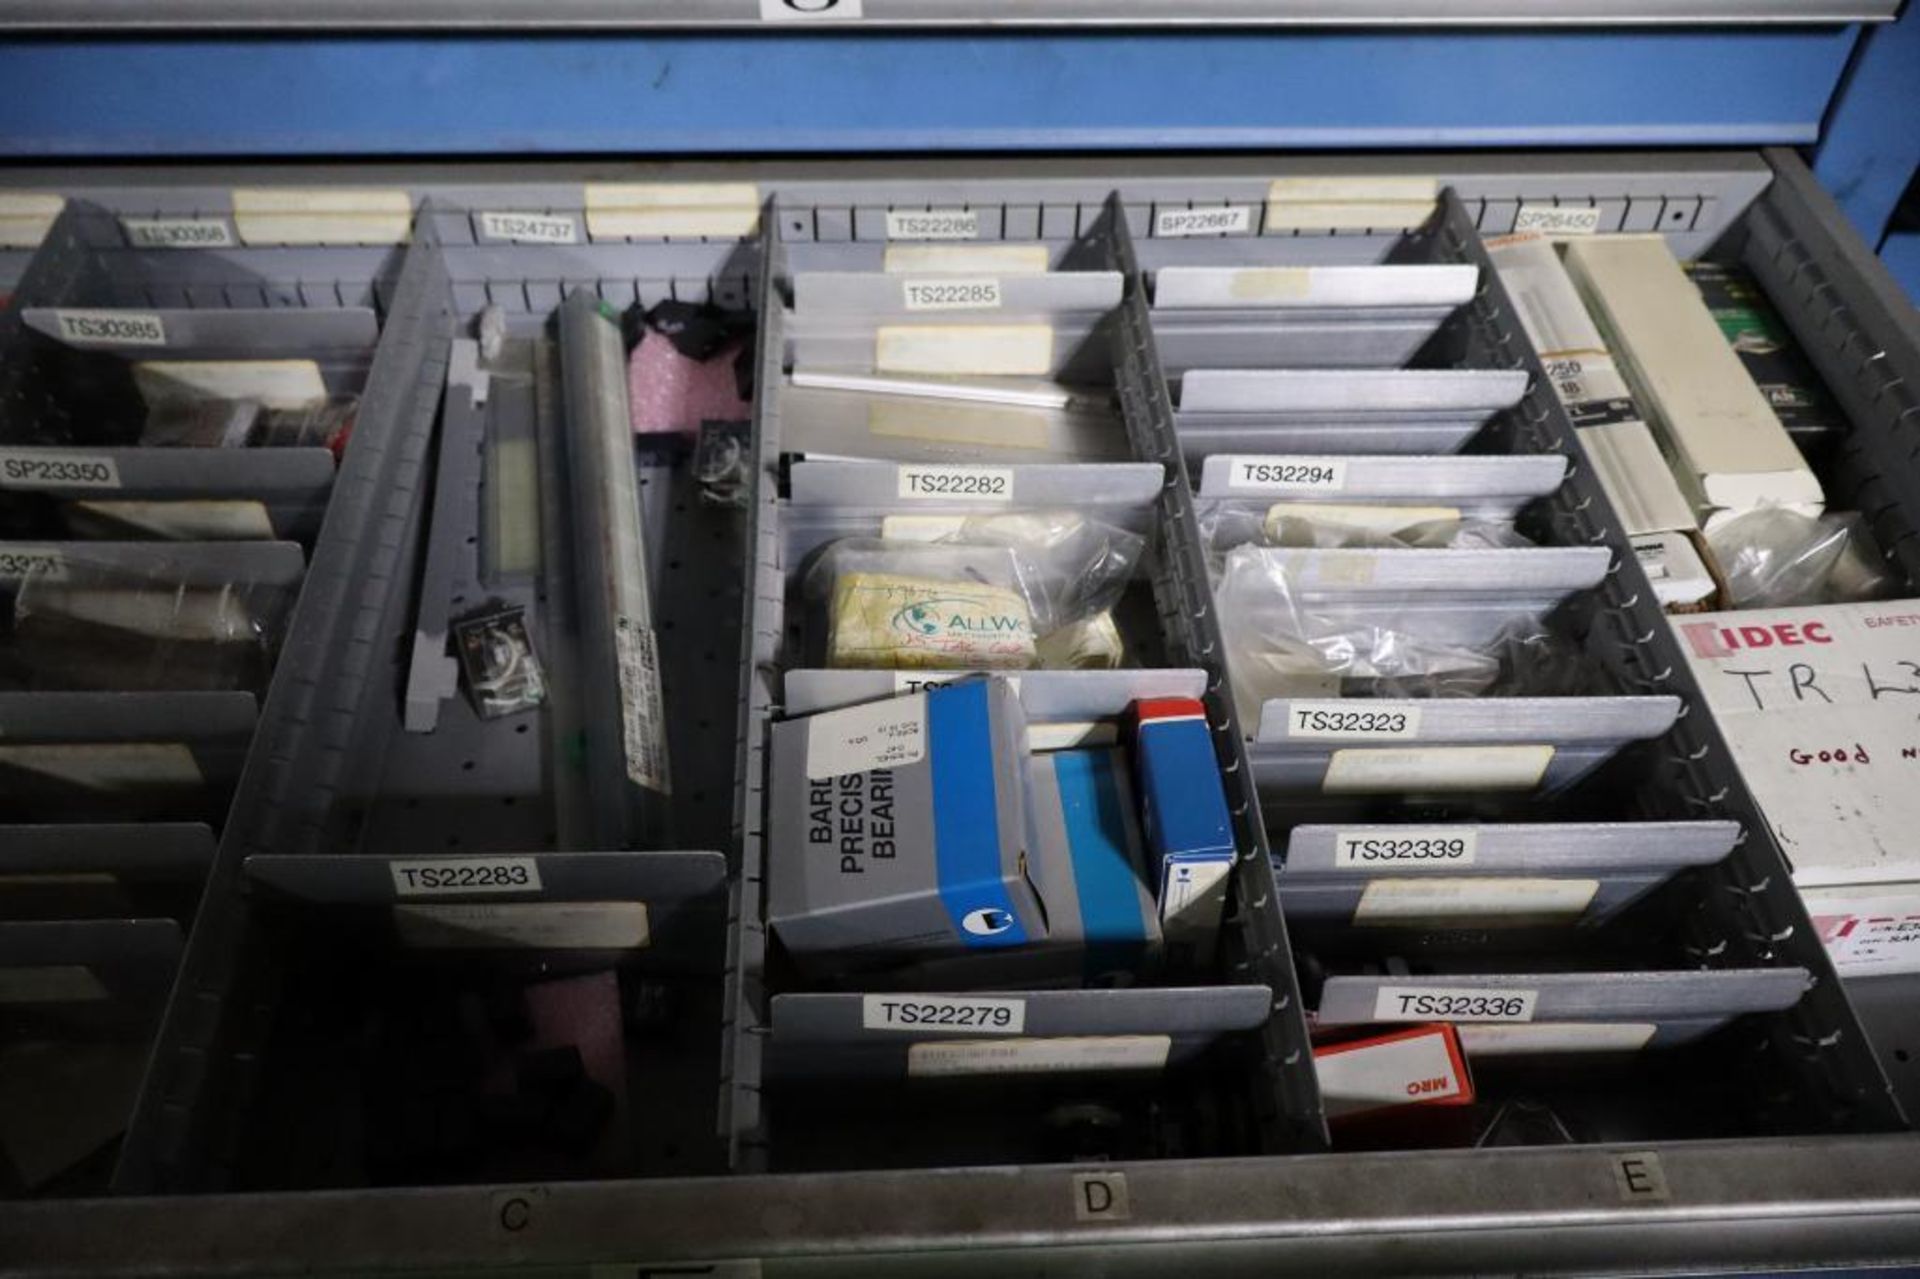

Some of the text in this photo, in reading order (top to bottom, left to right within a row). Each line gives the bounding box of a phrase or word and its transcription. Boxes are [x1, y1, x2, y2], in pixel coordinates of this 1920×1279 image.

[908, 284, 997, 304] TS22285
[62, 315, 161, 341] TS30385
[4, 457, 111, 482] SP23350
[1242, 463, 1335, 484] TS32294
[906, 473, 1006, 495] TS22282
[1718, 621, 1834, 651] IDEC
[1296, 709, 1407, 732] TS32323
[838, 773, 865, 874] PRECIS
[1345, 839, 1465, 860] TS32339
[400, 865, 530, 888] TS22283
[880, 1002, 1013, 1027] TS22279
[1395, 994, 1526, 1017] TS32336
[1621, 1159, 1652, 1194] E
[1083, 1179, 1113, 1213] D
[500, 1198, 529, 1232] C
